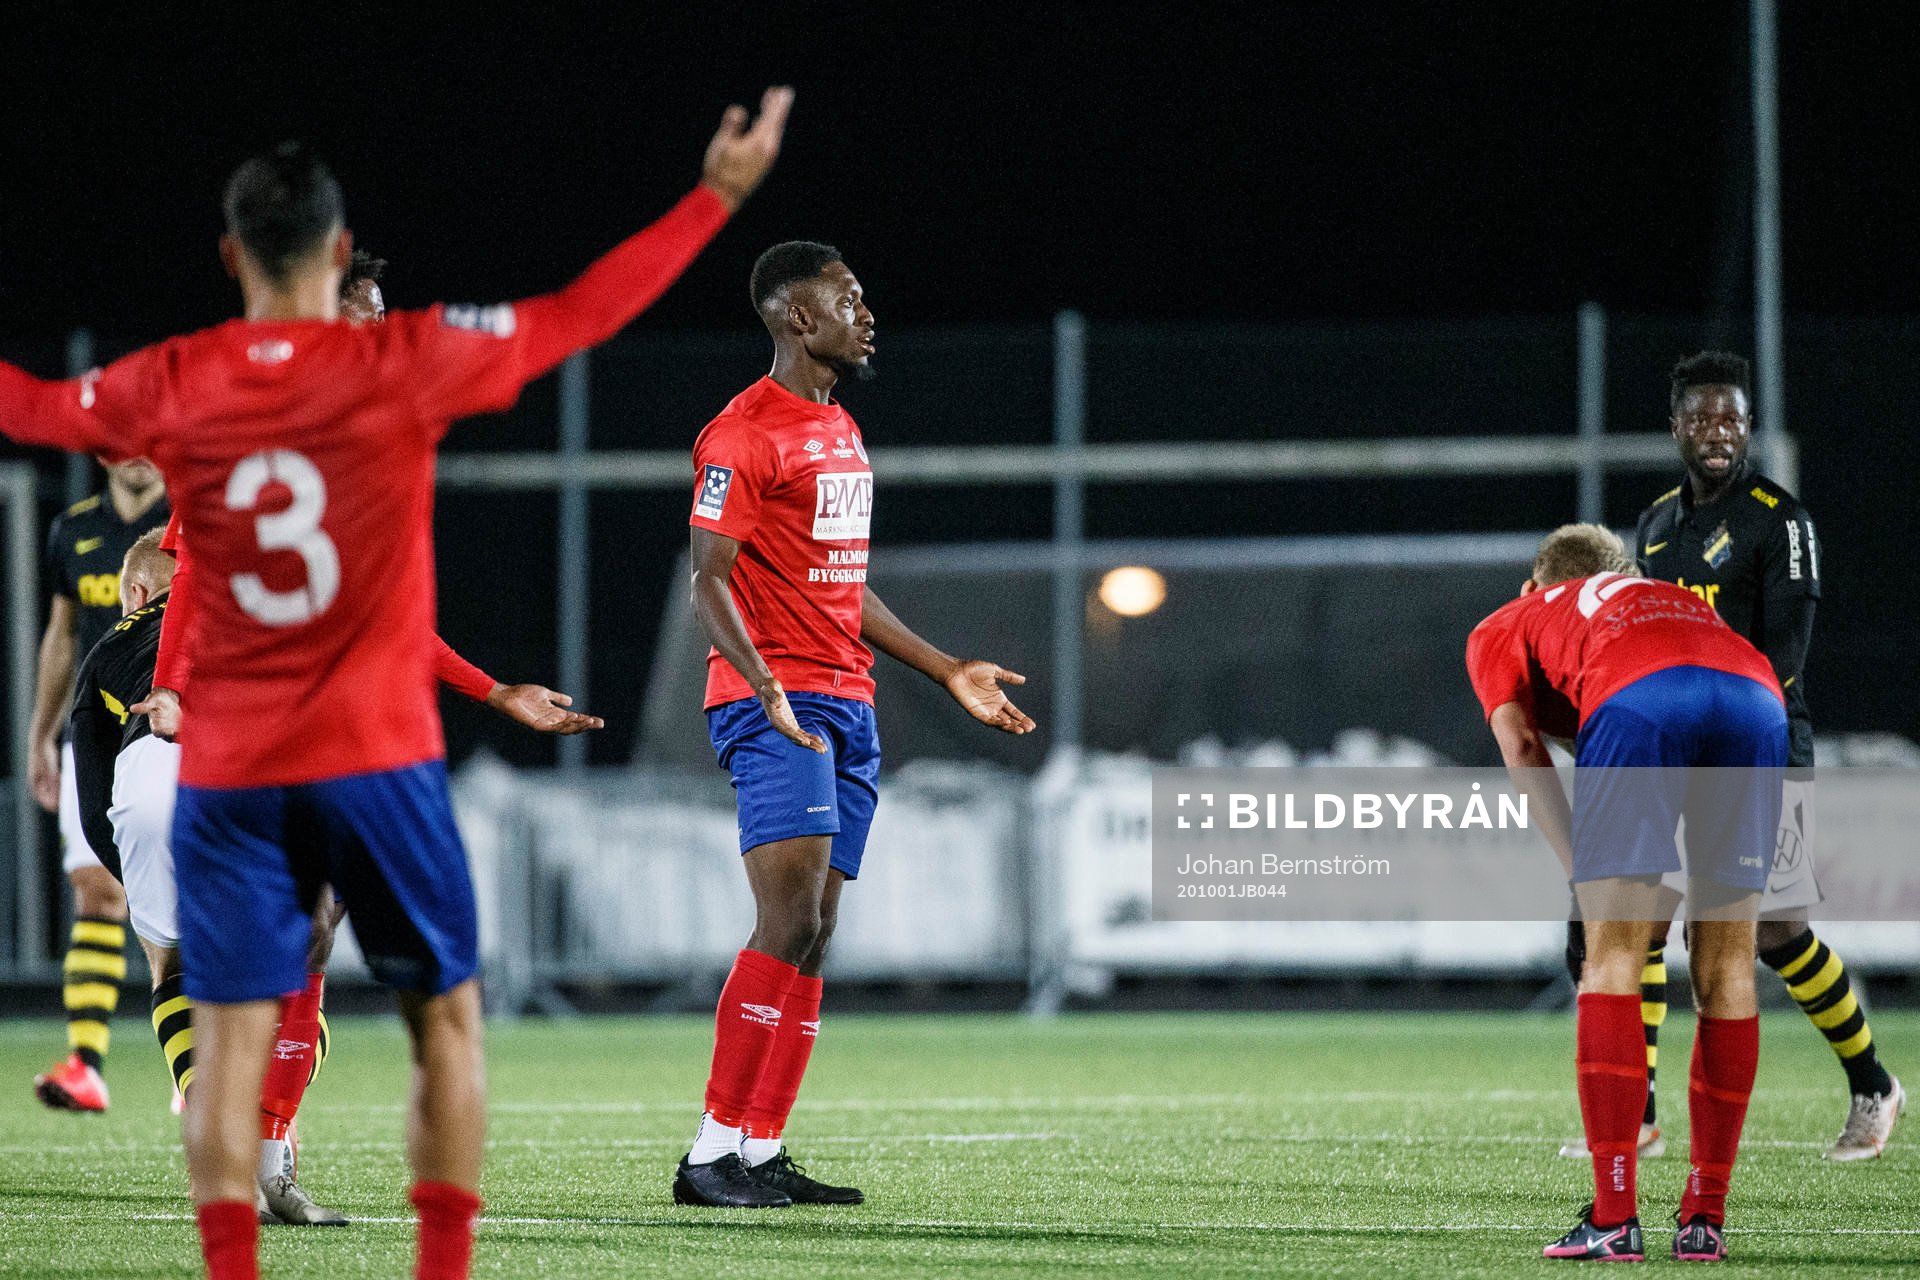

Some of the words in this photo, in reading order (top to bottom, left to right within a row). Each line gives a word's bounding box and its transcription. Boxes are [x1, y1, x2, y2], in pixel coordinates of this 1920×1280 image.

[225, 449, 340, 626] 3
[78, 568, 122, 608] no
[1611, 1155, 1625, 1192] umbro
